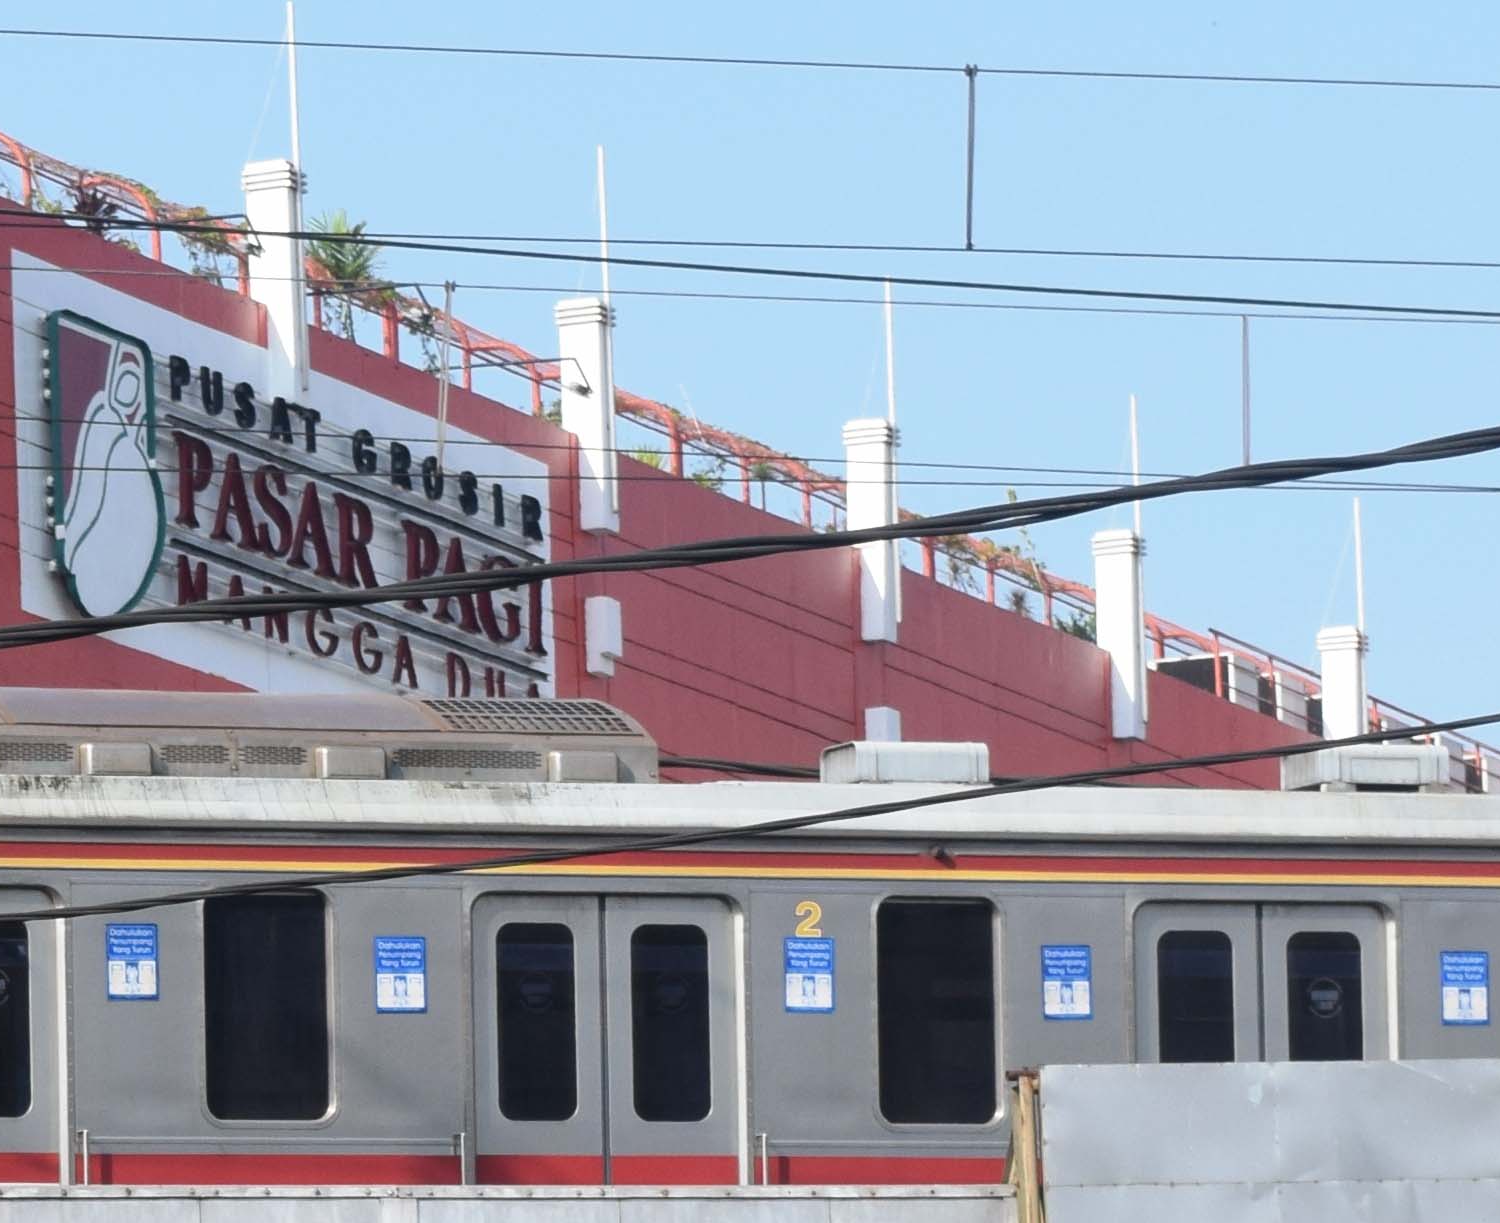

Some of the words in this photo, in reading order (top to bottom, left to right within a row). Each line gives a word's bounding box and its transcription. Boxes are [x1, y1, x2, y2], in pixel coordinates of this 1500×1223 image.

[169, 355, 321, 453] PUSAT
[351, 429, 543, 541] GROSIR
[172, 431, 379, 588] PASAR
[401, 519, 548, 656] PAGI
[177, 554, 418, 689] MANGGA
[446, 652, 541, 698] DU
[795, 901, 821, 937] 2
